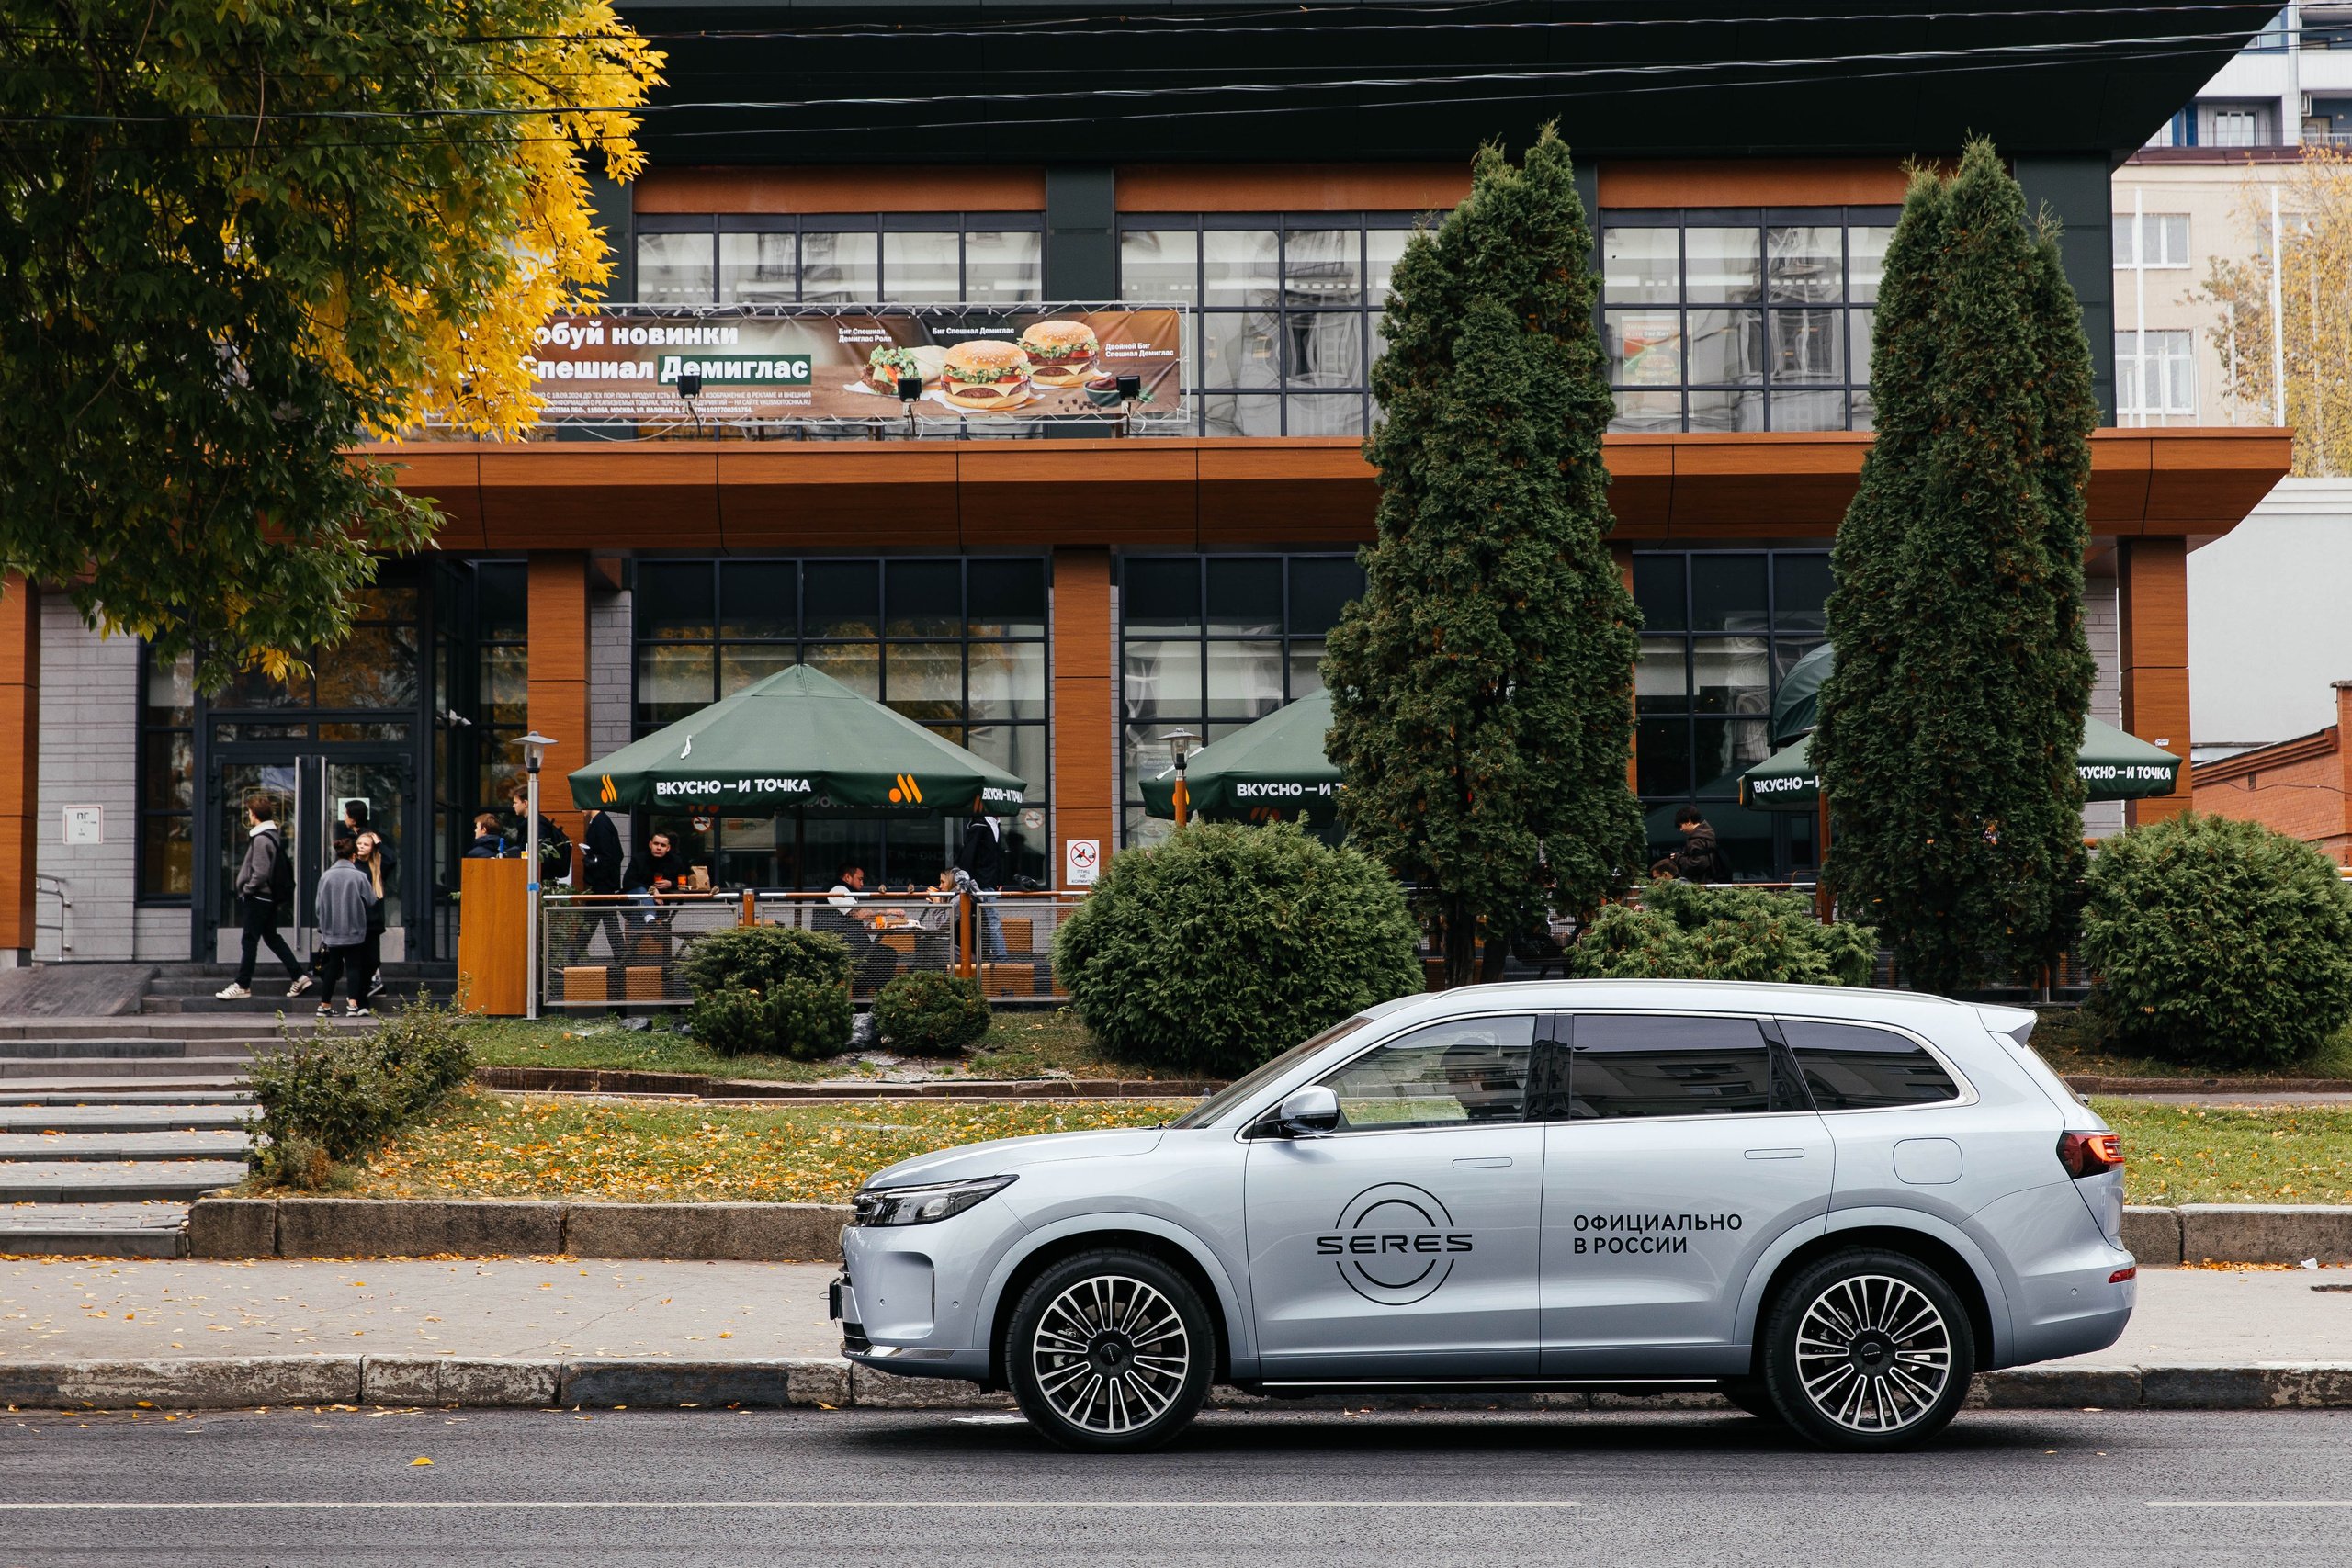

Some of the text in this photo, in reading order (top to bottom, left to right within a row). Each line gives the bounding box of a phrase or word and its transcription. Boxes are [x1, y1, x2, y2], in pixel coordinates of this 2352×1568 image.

[534, 321, 739, 351] обуй новинки
[979, 326, 1015, 335] Демиглас
[838, 335, 874, 344] Демиглас
[1105, 343, 1136, 351] Двойной
[1139, 349, 1174, 357] Демиглас
[661, 356, 808, 383] Демиглас
[784, 390, 811, 399] ВНЕШНИЙ
[688, 399, 728, 407] РЕДПРИЯТИЙ
[2077, 766, 2116, 780] КУСНО
[2136, 766, 2171, 780] ТОЧКА
[655, 780, 721, 795] ВКУСНО
[754, 778, 811, 794] ТОЧКА
[1237, 783, 1302, 797] ВКУСНО
[1753, 776, 1803, 793] ВКУСНО
[1573, 1213, 1743, 1234] ОФИЦИАЛЬНО
[1317, 1233, 1473, 1255] SERES
[1574, 1236, 1687, 1254] В РОССИИ
